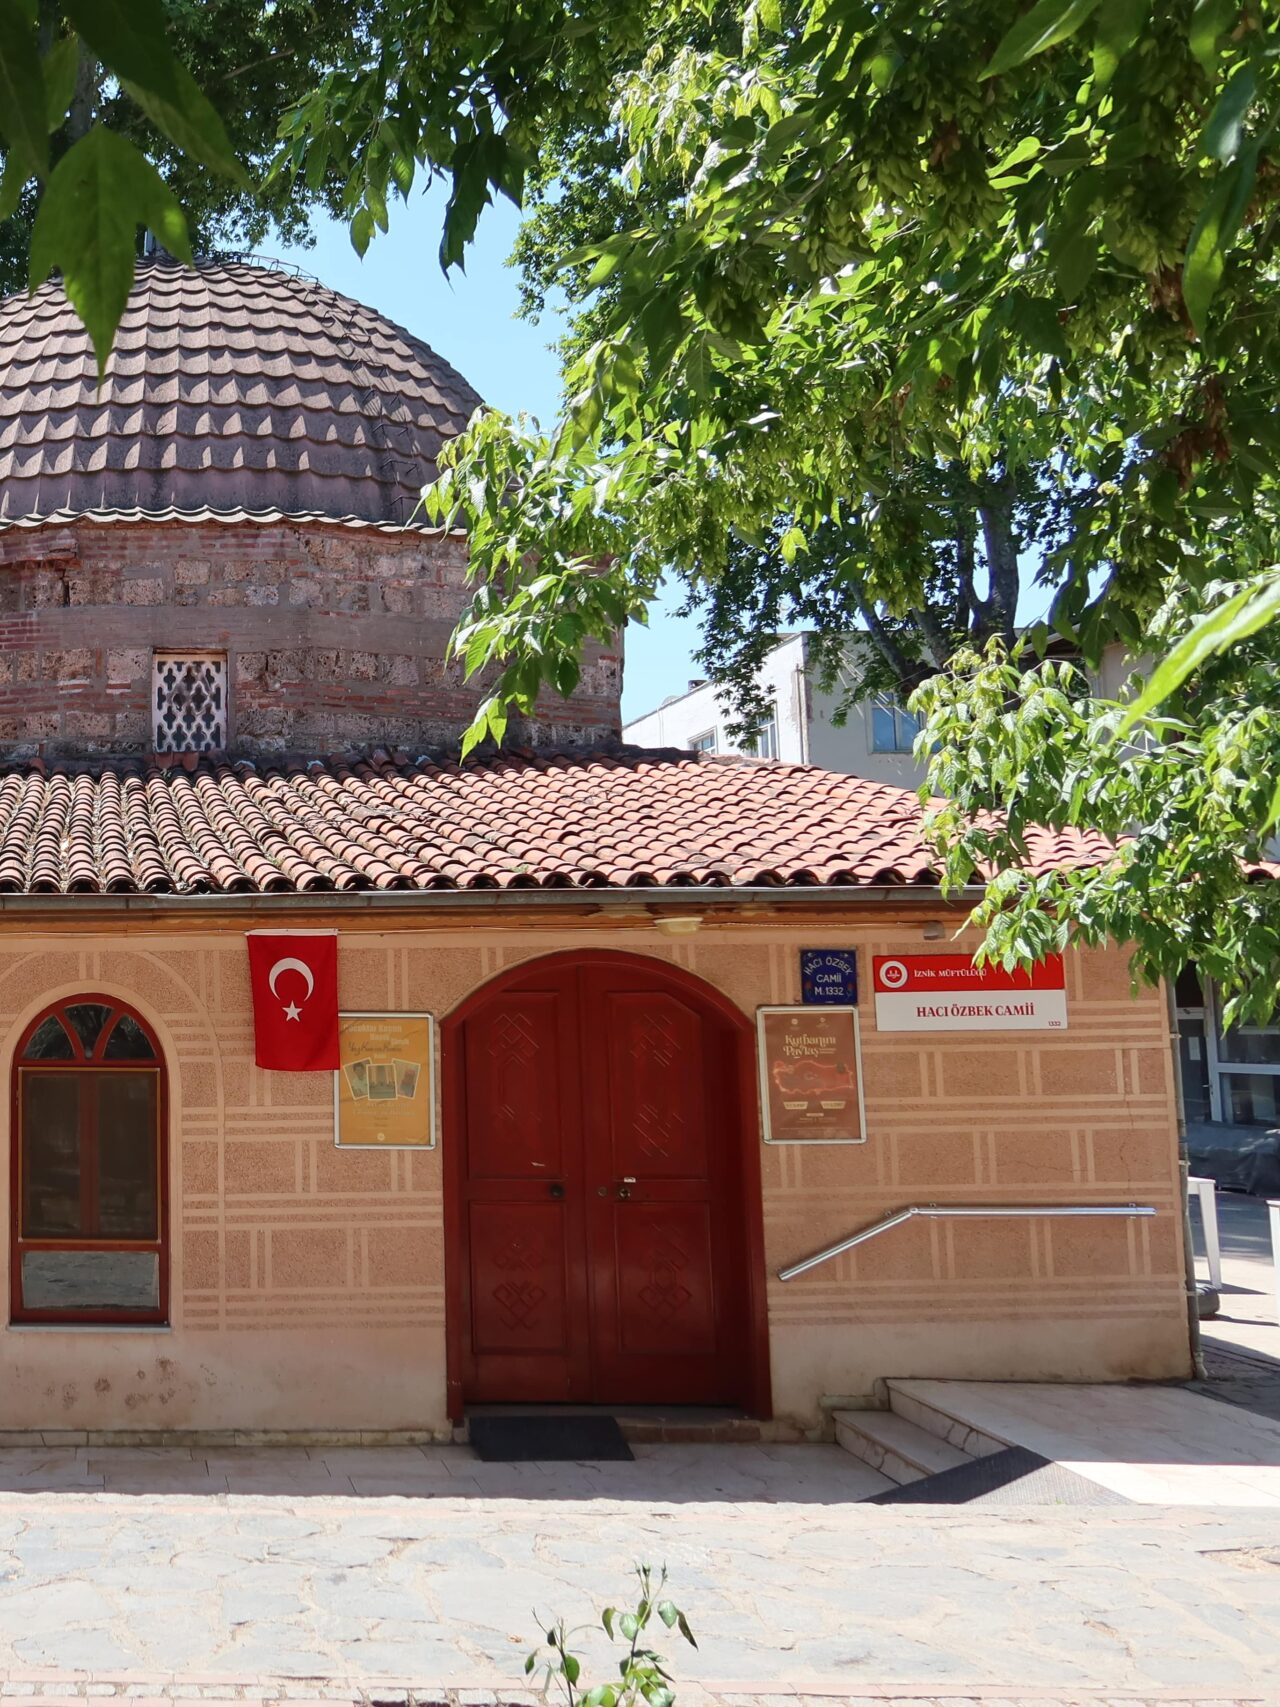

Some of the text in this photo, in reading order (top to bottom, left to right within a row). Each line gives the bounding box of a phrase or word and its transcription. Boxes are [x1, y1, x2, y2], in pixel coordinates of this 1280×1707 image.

[803, 957, 823, 976] HACI
[914, 968, 936, 977] İZNİK
[916, 1001, 1035, 1017] HACI ÖZBEK CAMİİ
